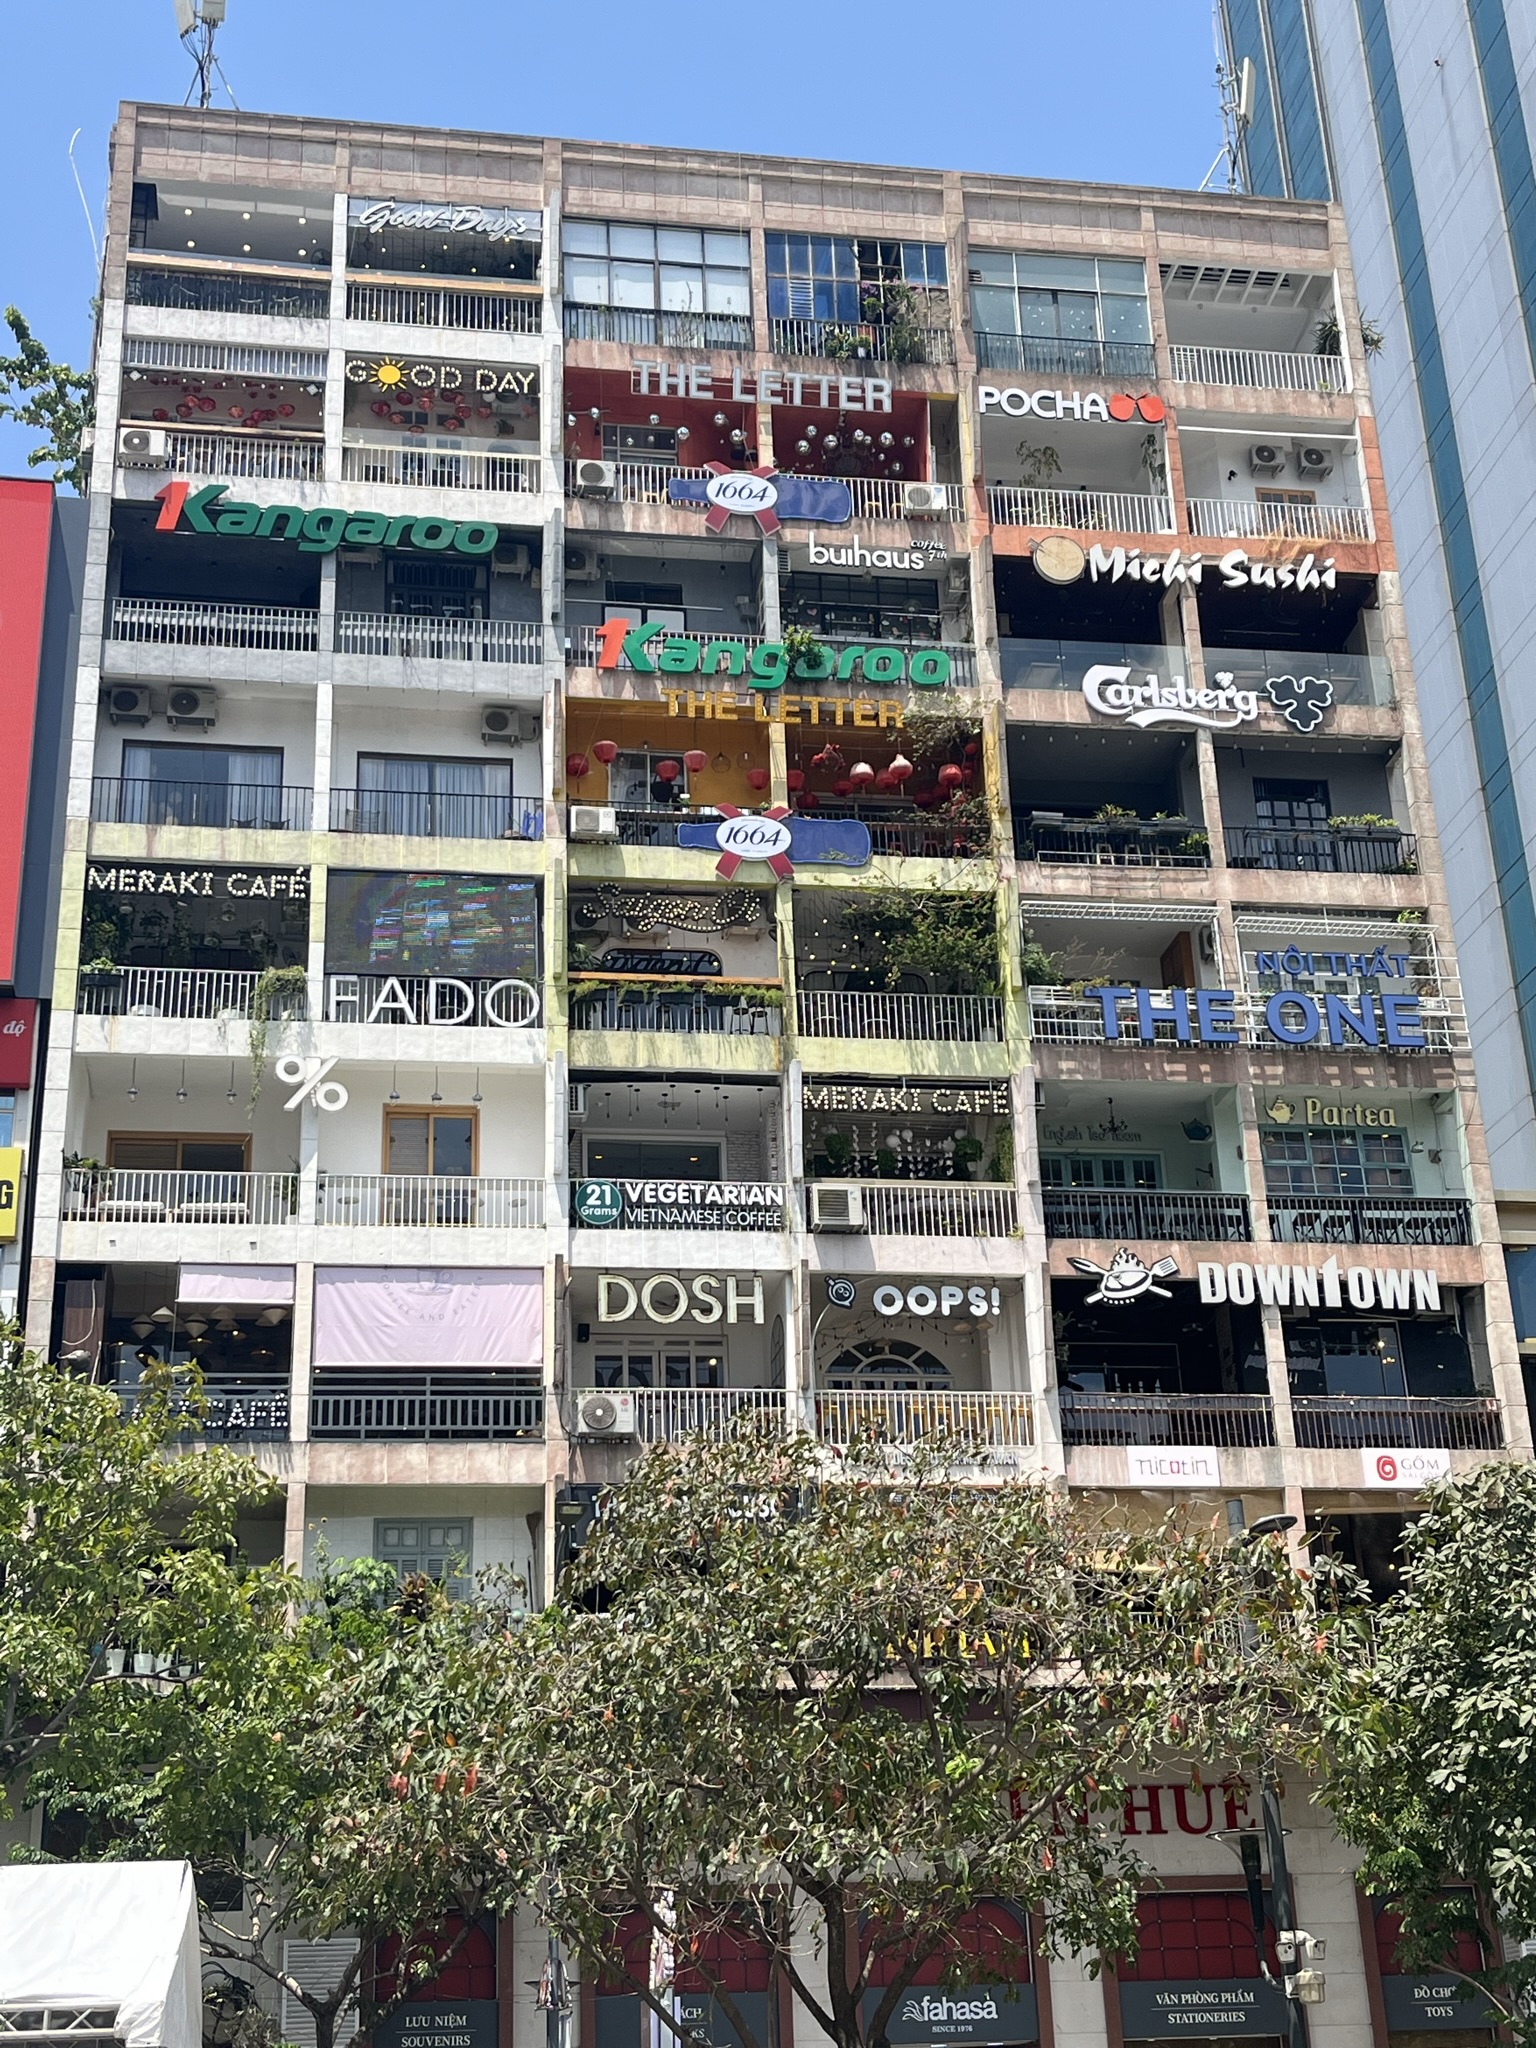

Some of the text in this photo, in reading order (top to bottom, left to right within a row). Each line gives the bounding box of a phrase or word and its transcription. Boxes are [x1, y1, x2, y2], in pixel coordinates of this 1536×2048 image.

[359, 201, 528, 242] Good Days
[475, 367, 536, 395] DAY
[631, 358, 893, 413] THE LETTER
[978, 385, 1110, 422] POCHA
[715, 480, 773, 502] 1664
[911, 540, 947, 550] coffee
[1089, 543, 1337, 591] Michi Sushi
[661, 688, 904, 728] THE LETTER
[1082, 663, 1259, 728] Carlsberg
[725, 824, 786, 847] 1664
[88, 866, 309, 900] MERAKI CAFÉ
[1324, 944, 1410, 980] THẤT
[329, 975, 541, 1028] FADO
[3, 1020, 26, 1037] độ
[1084, 987, 1427, 1049] THE ONE
[803, 1083, 1010, 1115] MERAKI CAFÉ
[1305, 1098, 1397, 1128] Partea
[586, 1184, 612, 1206] 21
[625, 1183, 784, 1206] VEGETARIAN
[580, 1206, 617, 1216] Grams
[625, 1207, 782, 1226] VIETNAMESE COFFEE
[597, 1273, 764, 1326] DOSH
[873, 1285, 1001, 1316] OOPS!
[419, 1313, 446, 1322] AND
[203, 1393, 288, 1427] CAFÉ
[920, 1995, 998, 2021] fahasa
[1156, 1992, 1179, 2005] VĂN
[1181, 1990, 1219, 2004] PHÒNG
[1424, 2006, 1454, 2017] TOYS
[931, 2025, 973, 2033] SINCE 1976
[1167, 2011, 1246, 2024] STATIONERIES
[401, 2035, 471, 2048] SOUVENIRS
